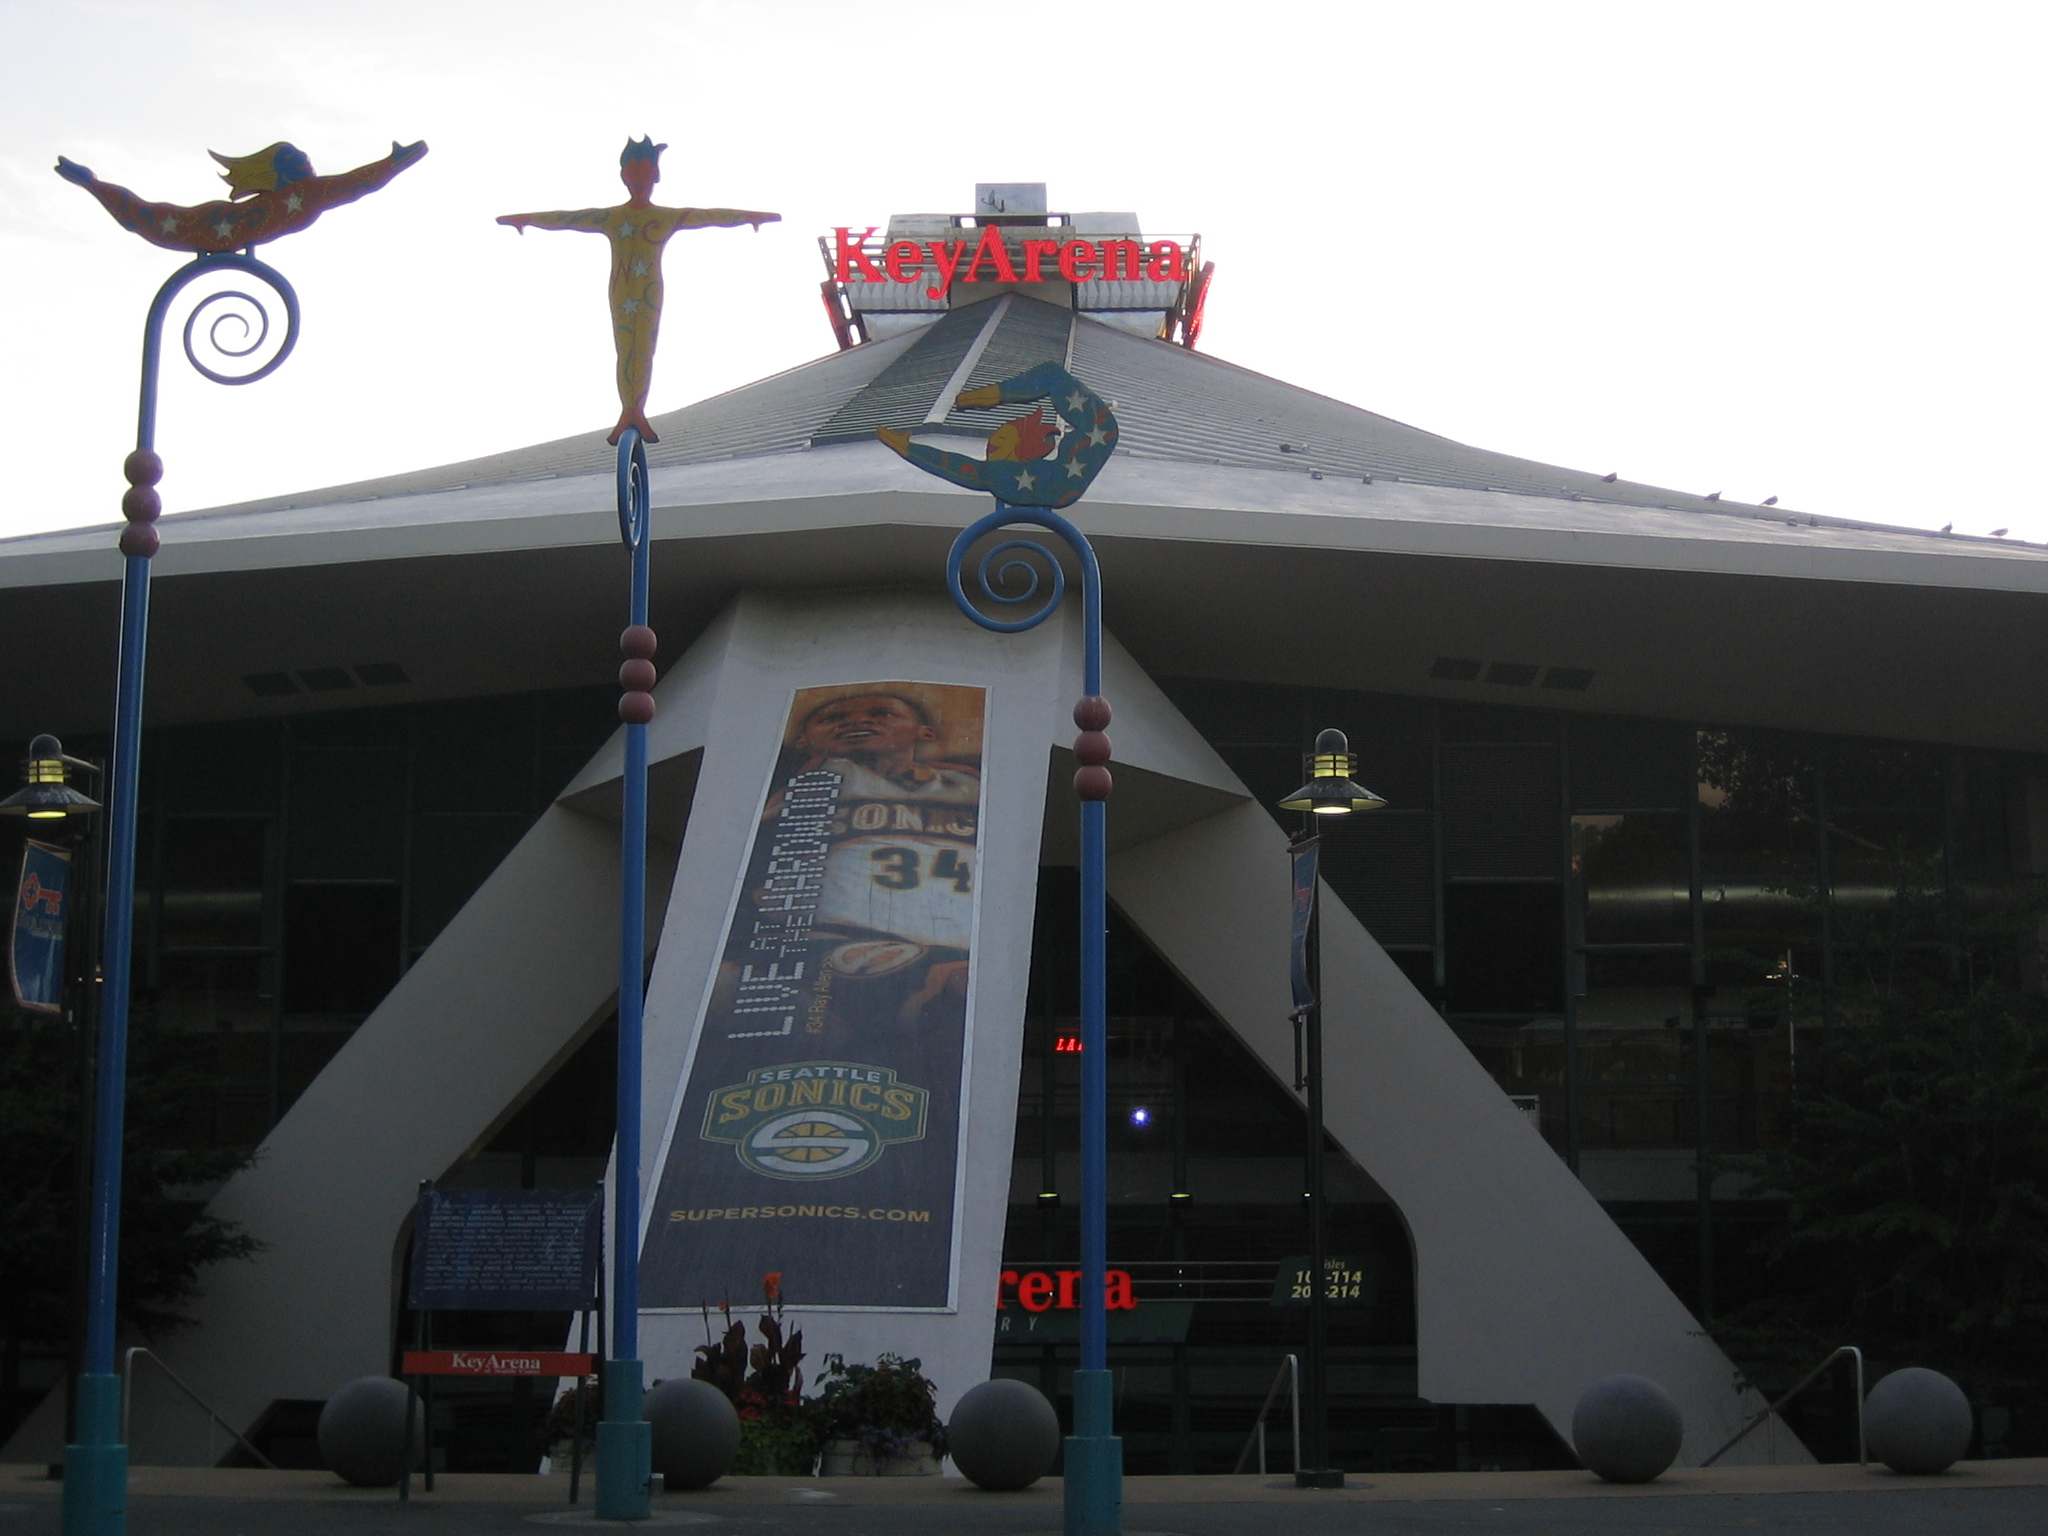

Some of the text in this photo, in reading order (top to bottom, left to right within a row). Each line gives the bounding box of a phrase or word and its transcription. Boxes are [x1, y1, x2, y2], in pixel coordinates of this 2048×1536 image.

[832, 224, 1189, 300] KeyArena
[868, 846, 971, 893] 34
[727, 770, 843, 1039] LIVE AT THE HARDWOOD
[759, 1067, 881, 1084] SEATTLE
[718, 1078, 916, 1124] SONICS
[669, 1205, 931, 1223] SUPERSONICS.COM
[1323, 1258, 1345, 1269] isles
[997, 1269, 1139, 1312] rena
[452, 1353, 541, 1372] KeyArena
